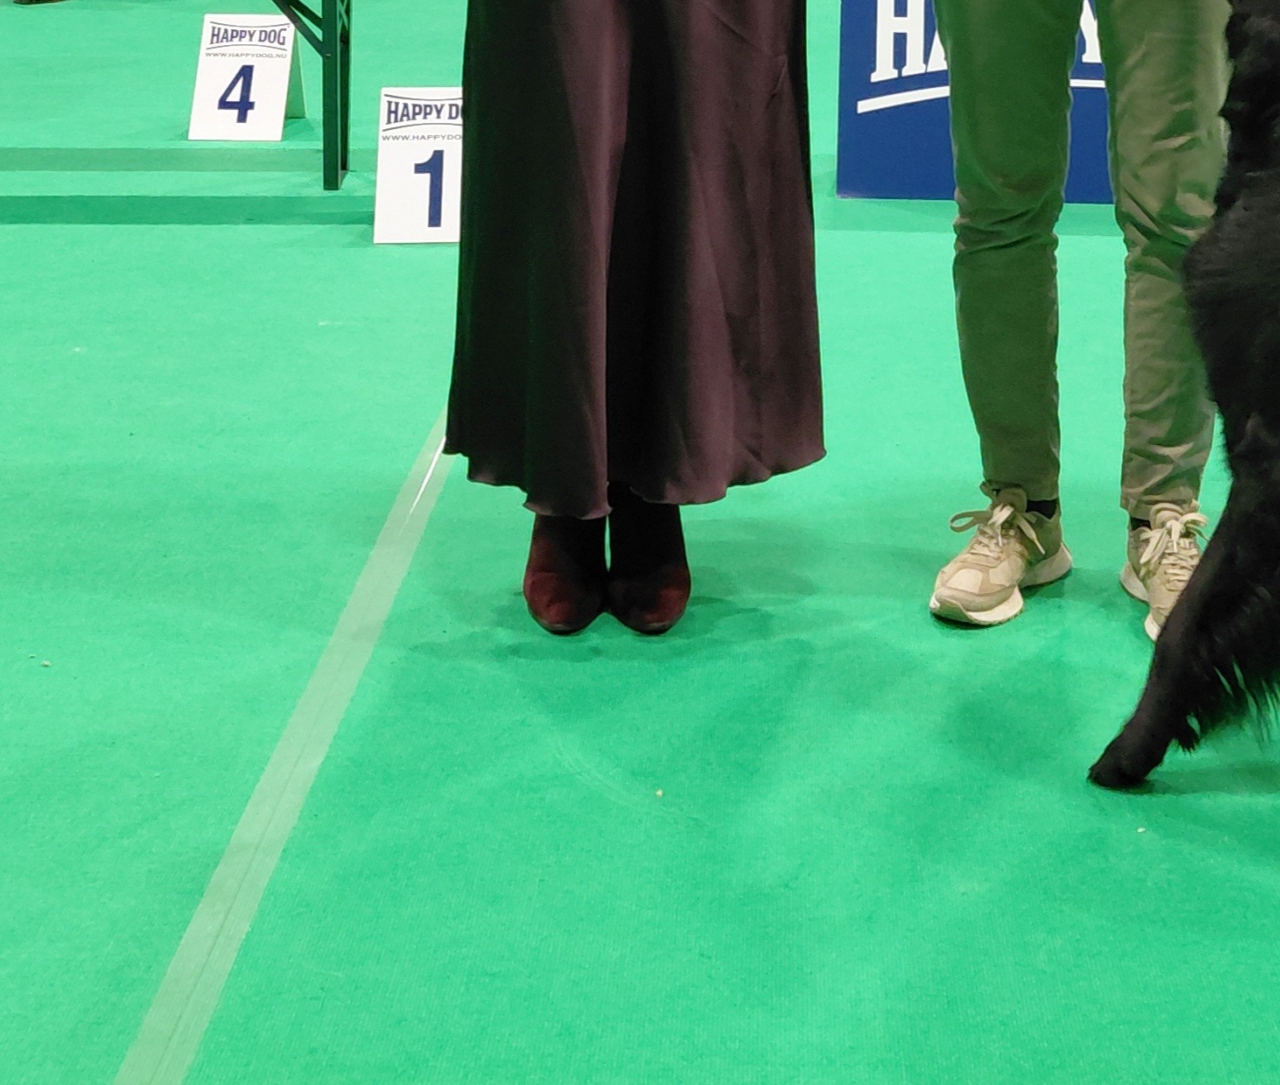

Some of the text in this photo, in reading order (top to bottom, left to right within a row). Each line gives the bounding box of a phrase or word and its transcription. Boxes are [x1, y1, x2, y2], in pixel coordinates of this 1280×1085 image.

[209, 26, 287, 45] HAPPY DOG
[216, 64, 255, 123] 4
[385, 100, 445, 125] HAPPY
[382, 134, 462, 142] WWW.HAPPYDO
[414, 149, 444, 227] 1
